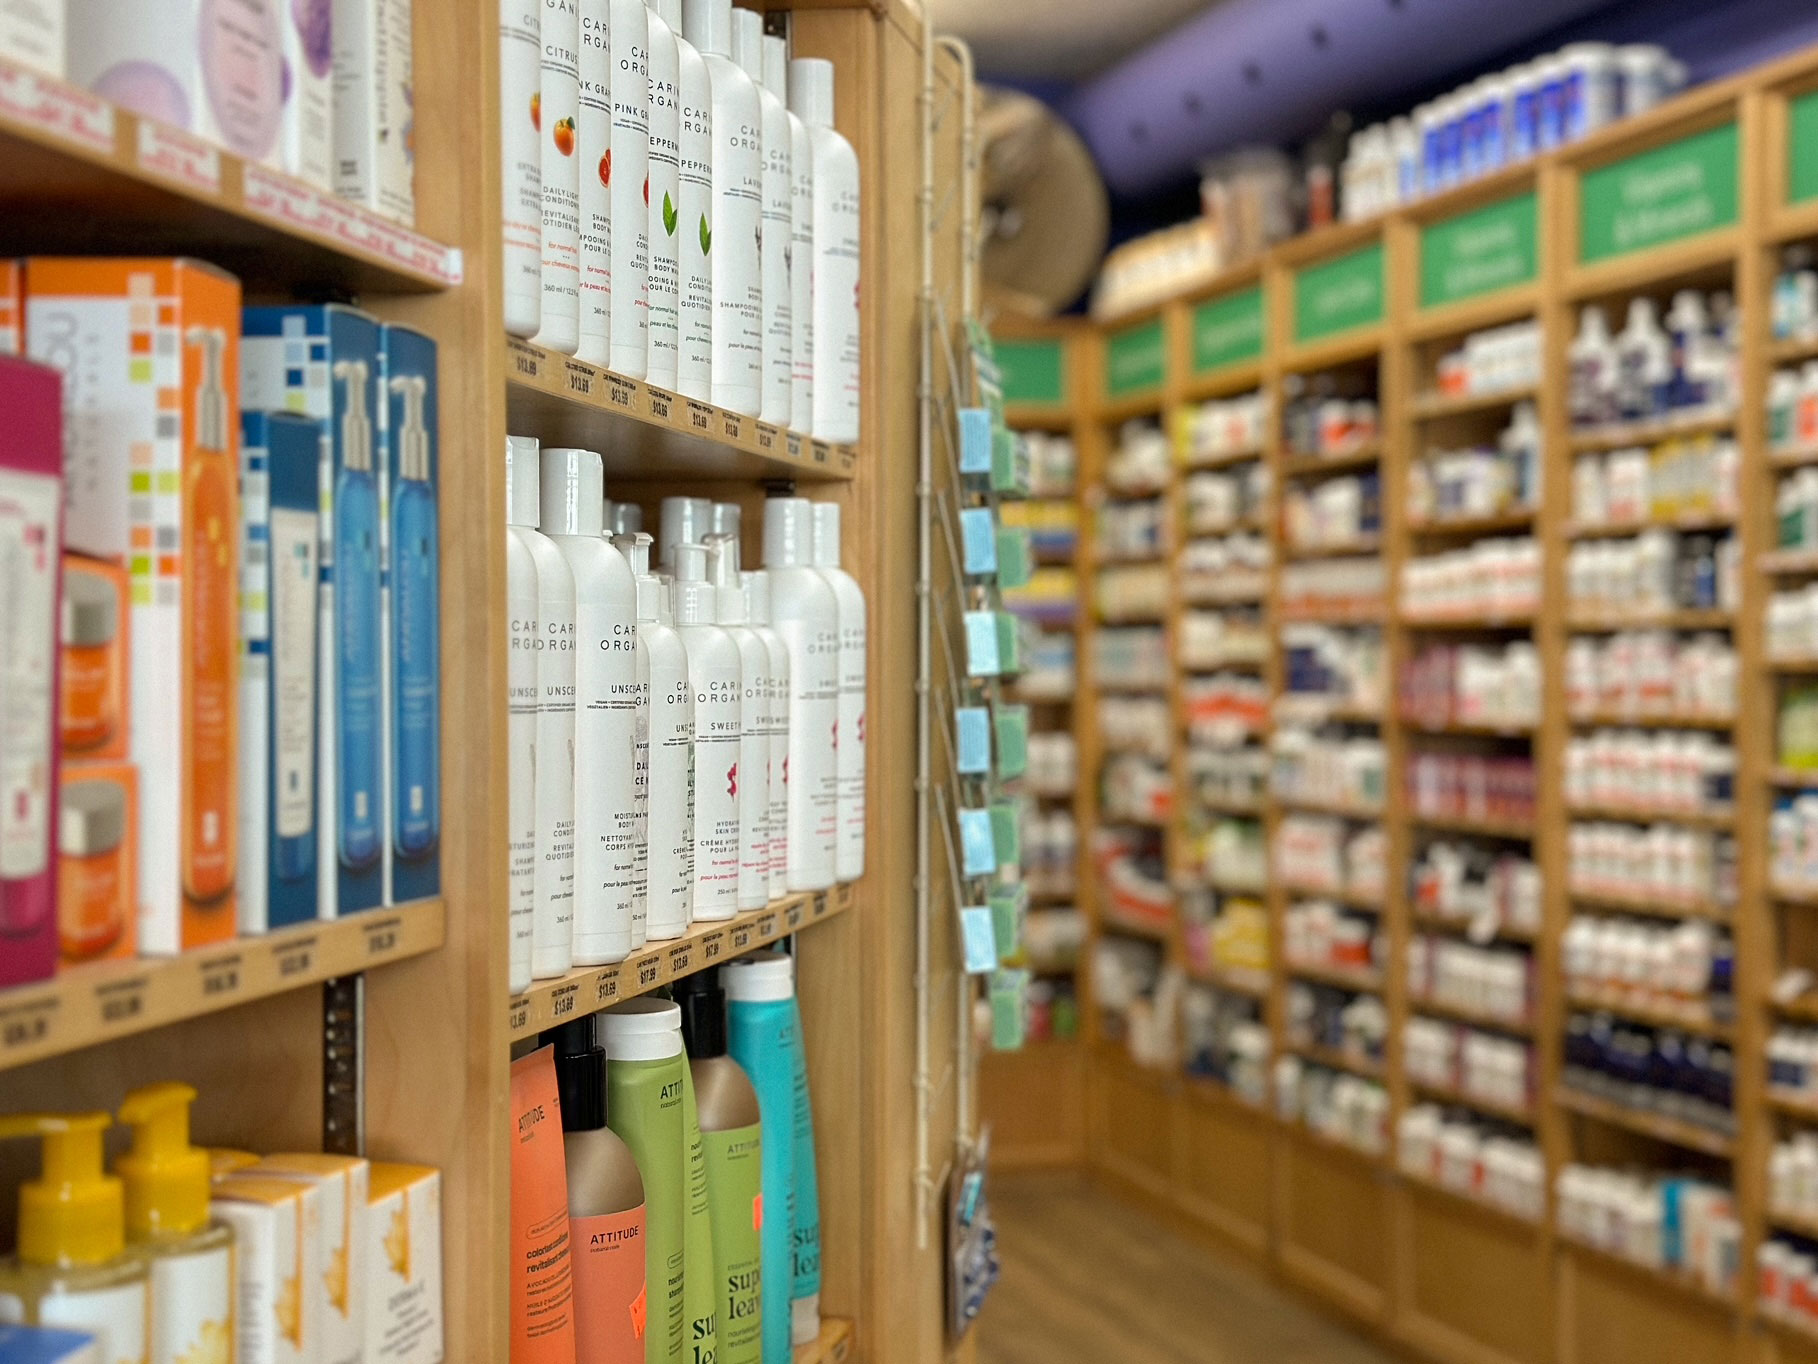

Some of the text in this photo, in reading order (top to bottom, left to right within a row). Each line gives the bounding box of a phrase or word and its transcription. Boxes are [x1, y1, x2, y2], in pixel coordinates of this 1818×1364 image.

[615, 103, 638, 116] PINK
[519, 1105, 545, 1133] ATTITUDE
[590, 1225, 639, 1245] ATTITUDE
